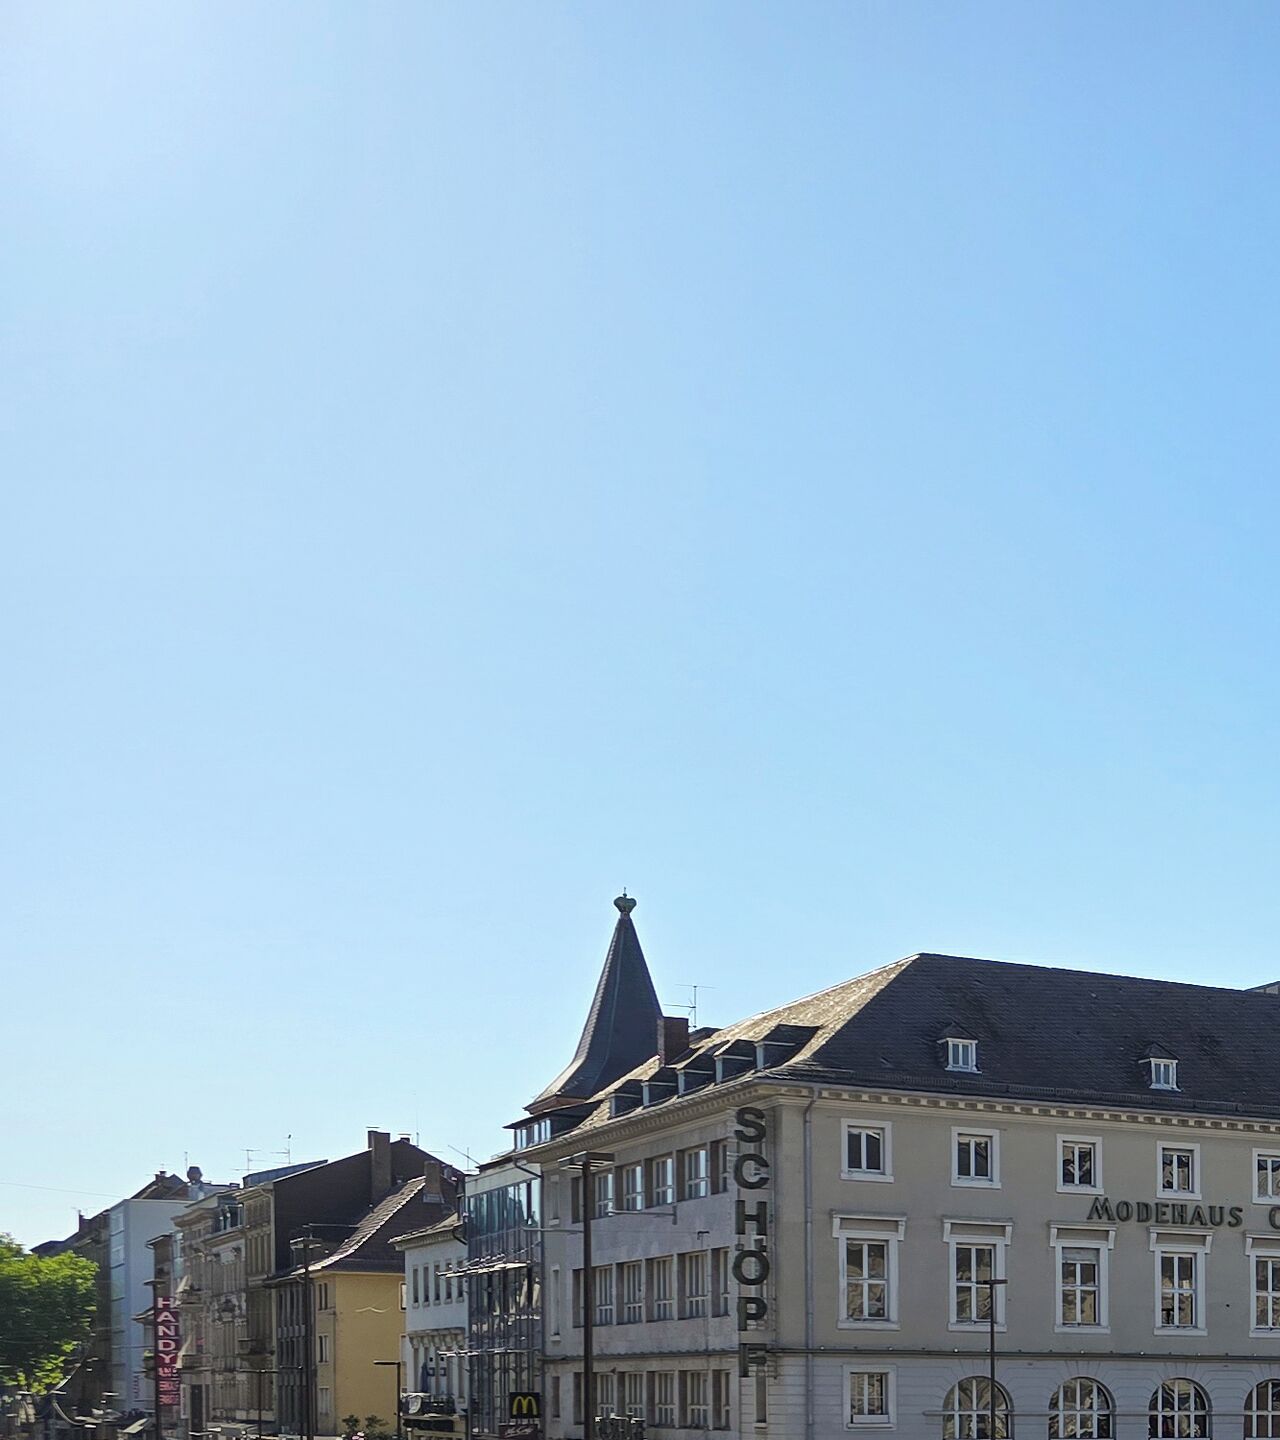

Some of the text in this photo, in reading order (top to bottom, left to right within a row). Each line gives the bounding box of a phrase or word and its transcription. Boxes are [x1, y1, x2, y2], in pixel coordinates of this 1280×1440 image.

[733, 1106, 771, 1377] SCHÖPF
[1087, 1196, 1243, 1228] MODEHAUS
[157, 1297, 176, 1364] HANDY
